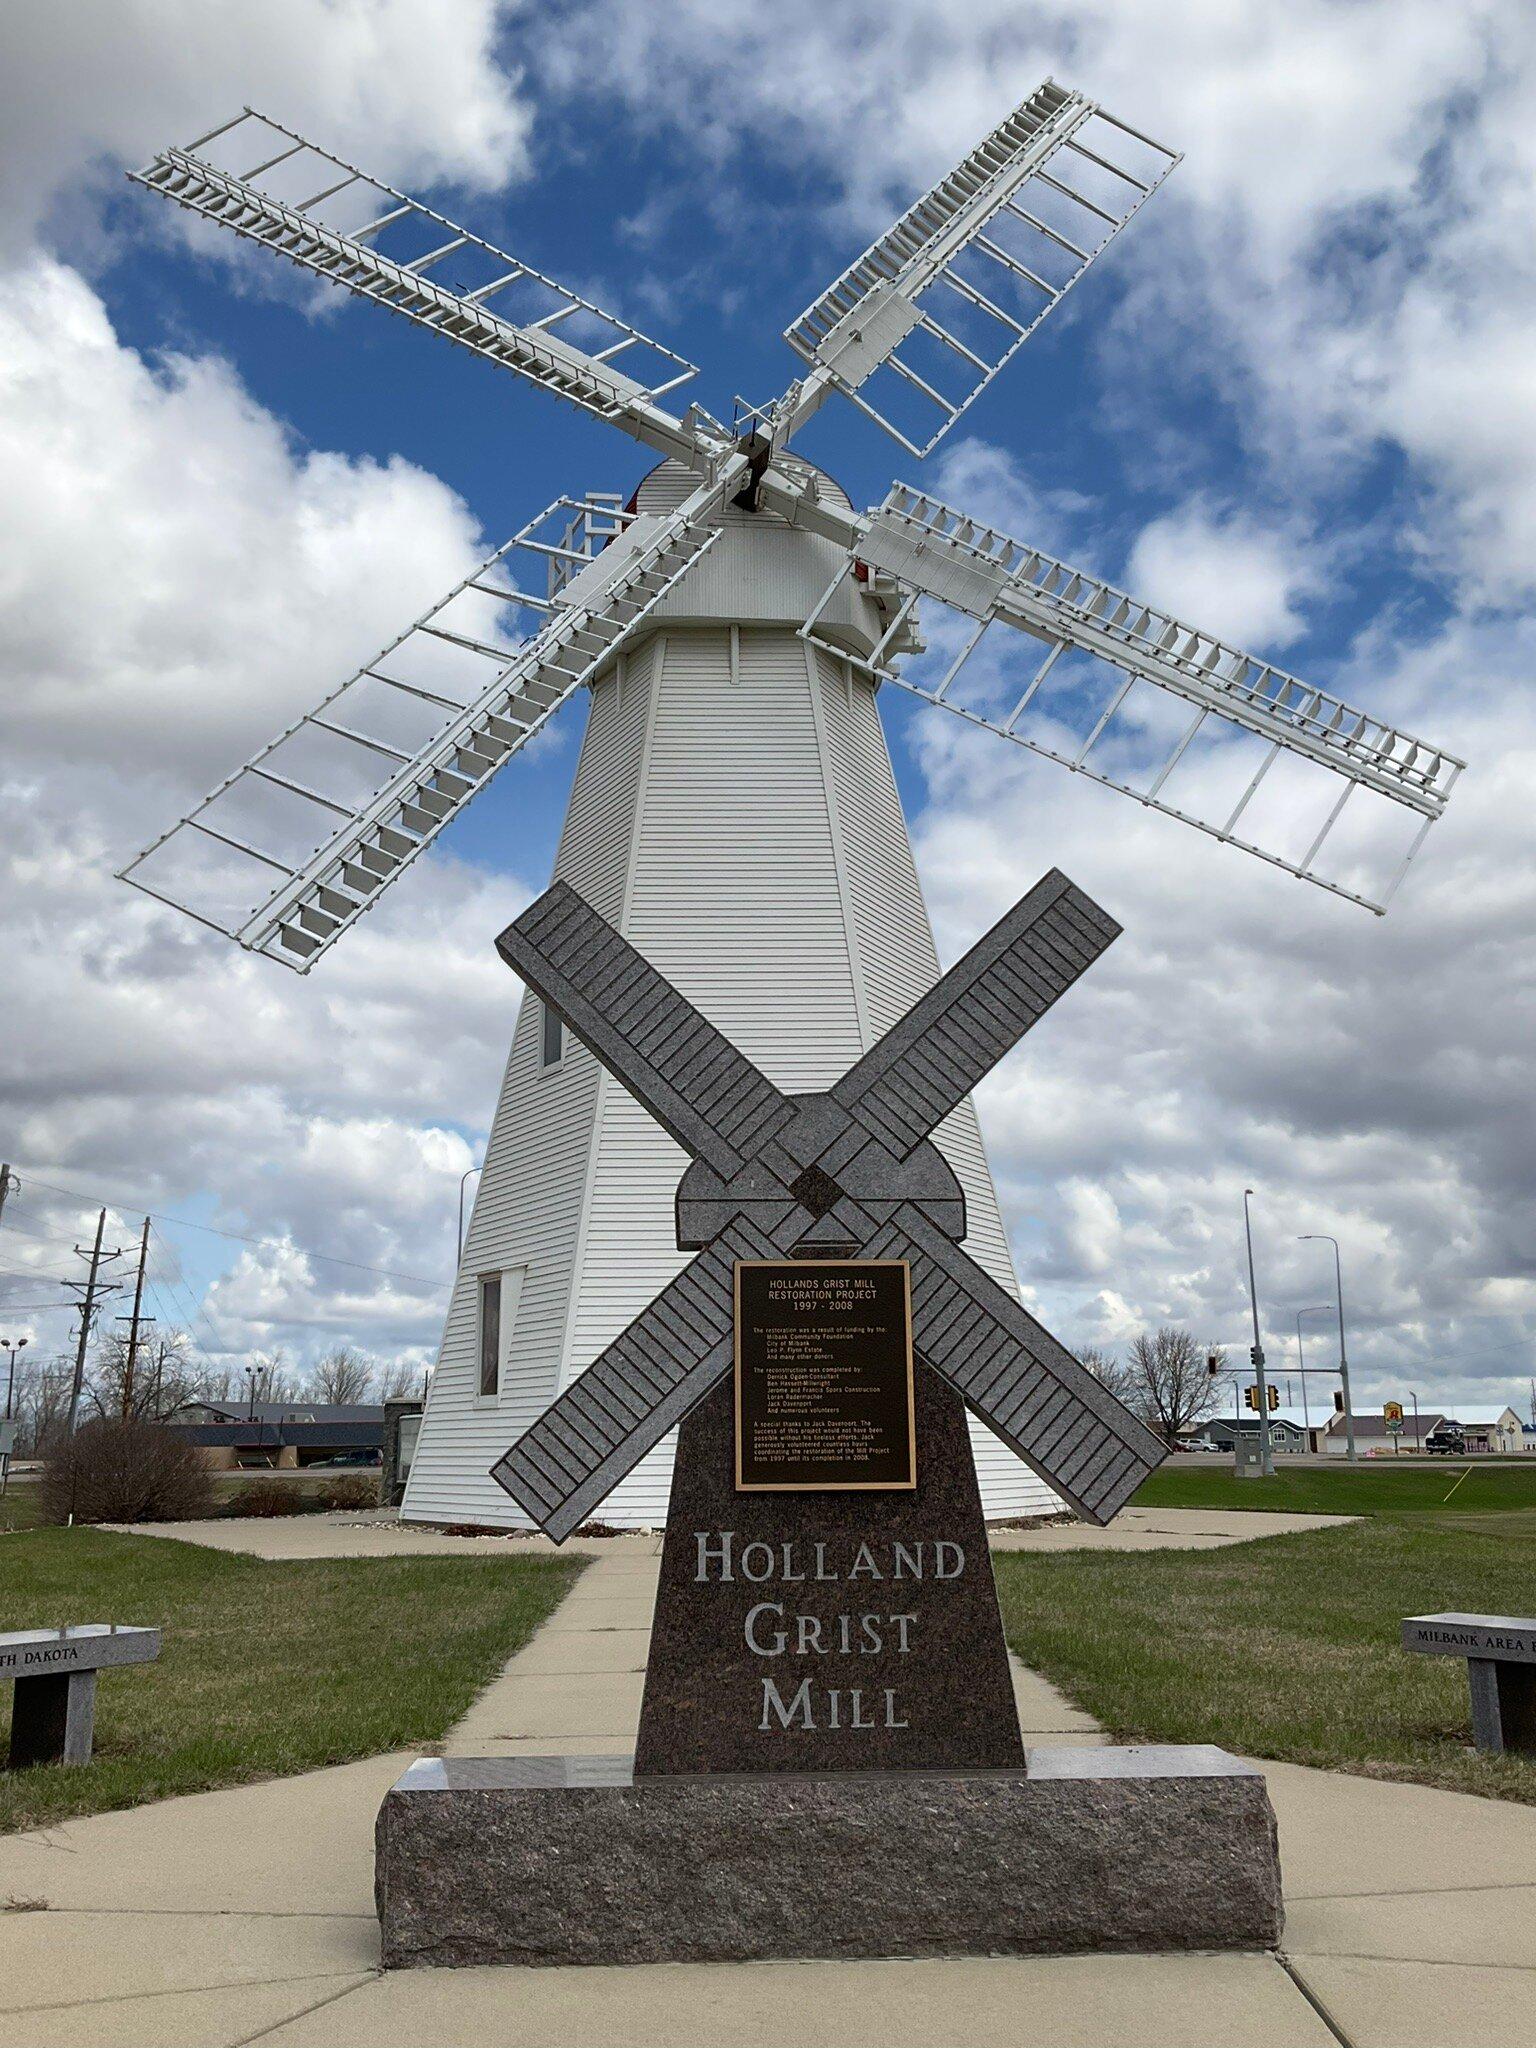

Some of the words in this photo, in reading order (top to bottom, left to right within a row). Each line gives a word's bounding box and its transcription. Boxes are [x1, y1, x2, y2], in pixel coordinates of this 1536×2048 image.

[770, 1280, 819, 1289] HOLLANDS
[823, 1279, 849, 1289] GRIST
[854, 1279, 875, 1288] MILL
[768, 1291, 831, 1299] RESTORATION
[836, 1290, 877, 1299] PROJECT
[794, 1302, 816, 1310] 1997
[829, 1301, 853, 1310] 2008
[694, 1531, 966, 1582] HOLLAND
[744, 1602, 918, 1657] GRIST
[1418, 1630, 1478, 1646] MILBANK
[1485, 1637, 1524, 1650] AREA
[25, 1648, 78, 1664] DAKOTA
[758, 1678, 909, 1730] MILL
